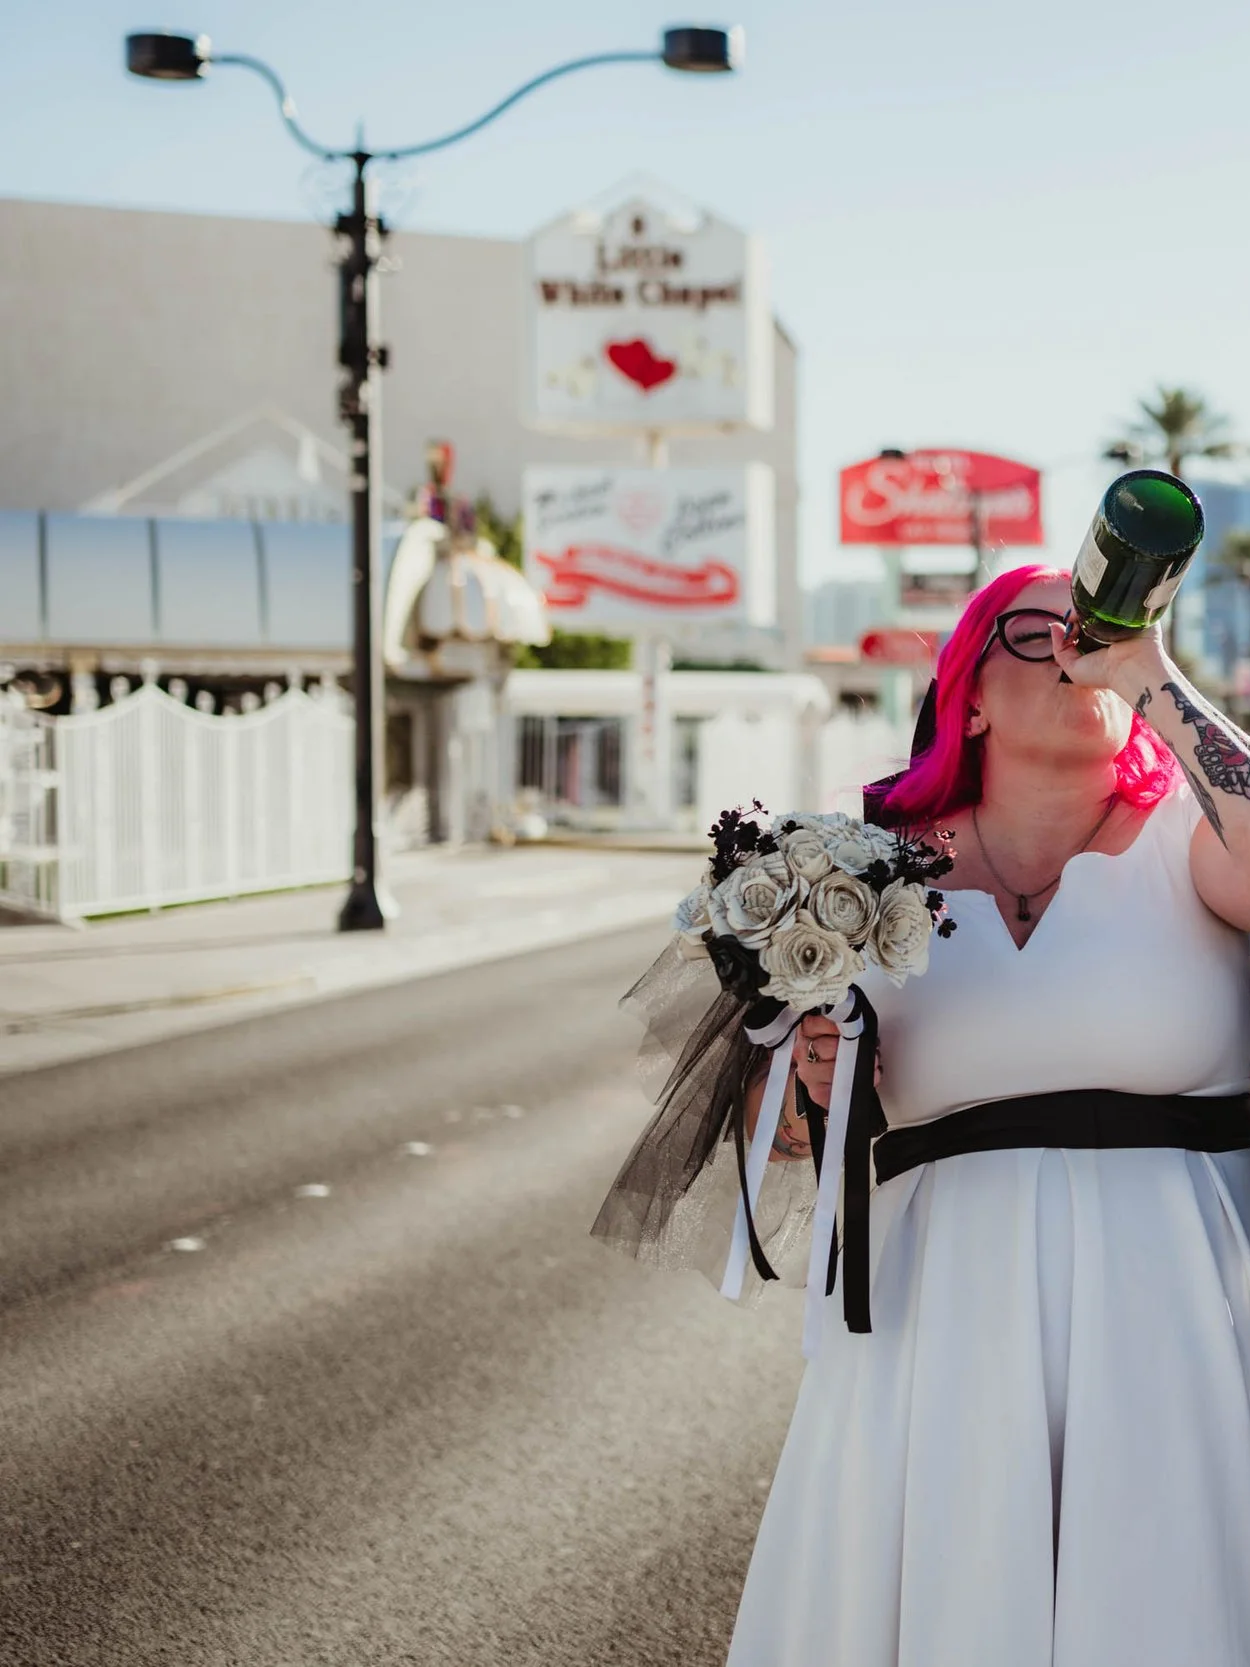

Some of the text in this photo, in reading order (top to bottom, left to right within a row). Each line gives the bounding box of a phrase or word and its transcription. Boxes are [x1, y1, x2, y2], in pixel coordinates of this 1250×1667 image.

[596, 240, 682, 275] Little
[538, 278, 742, 316] White Chapel
